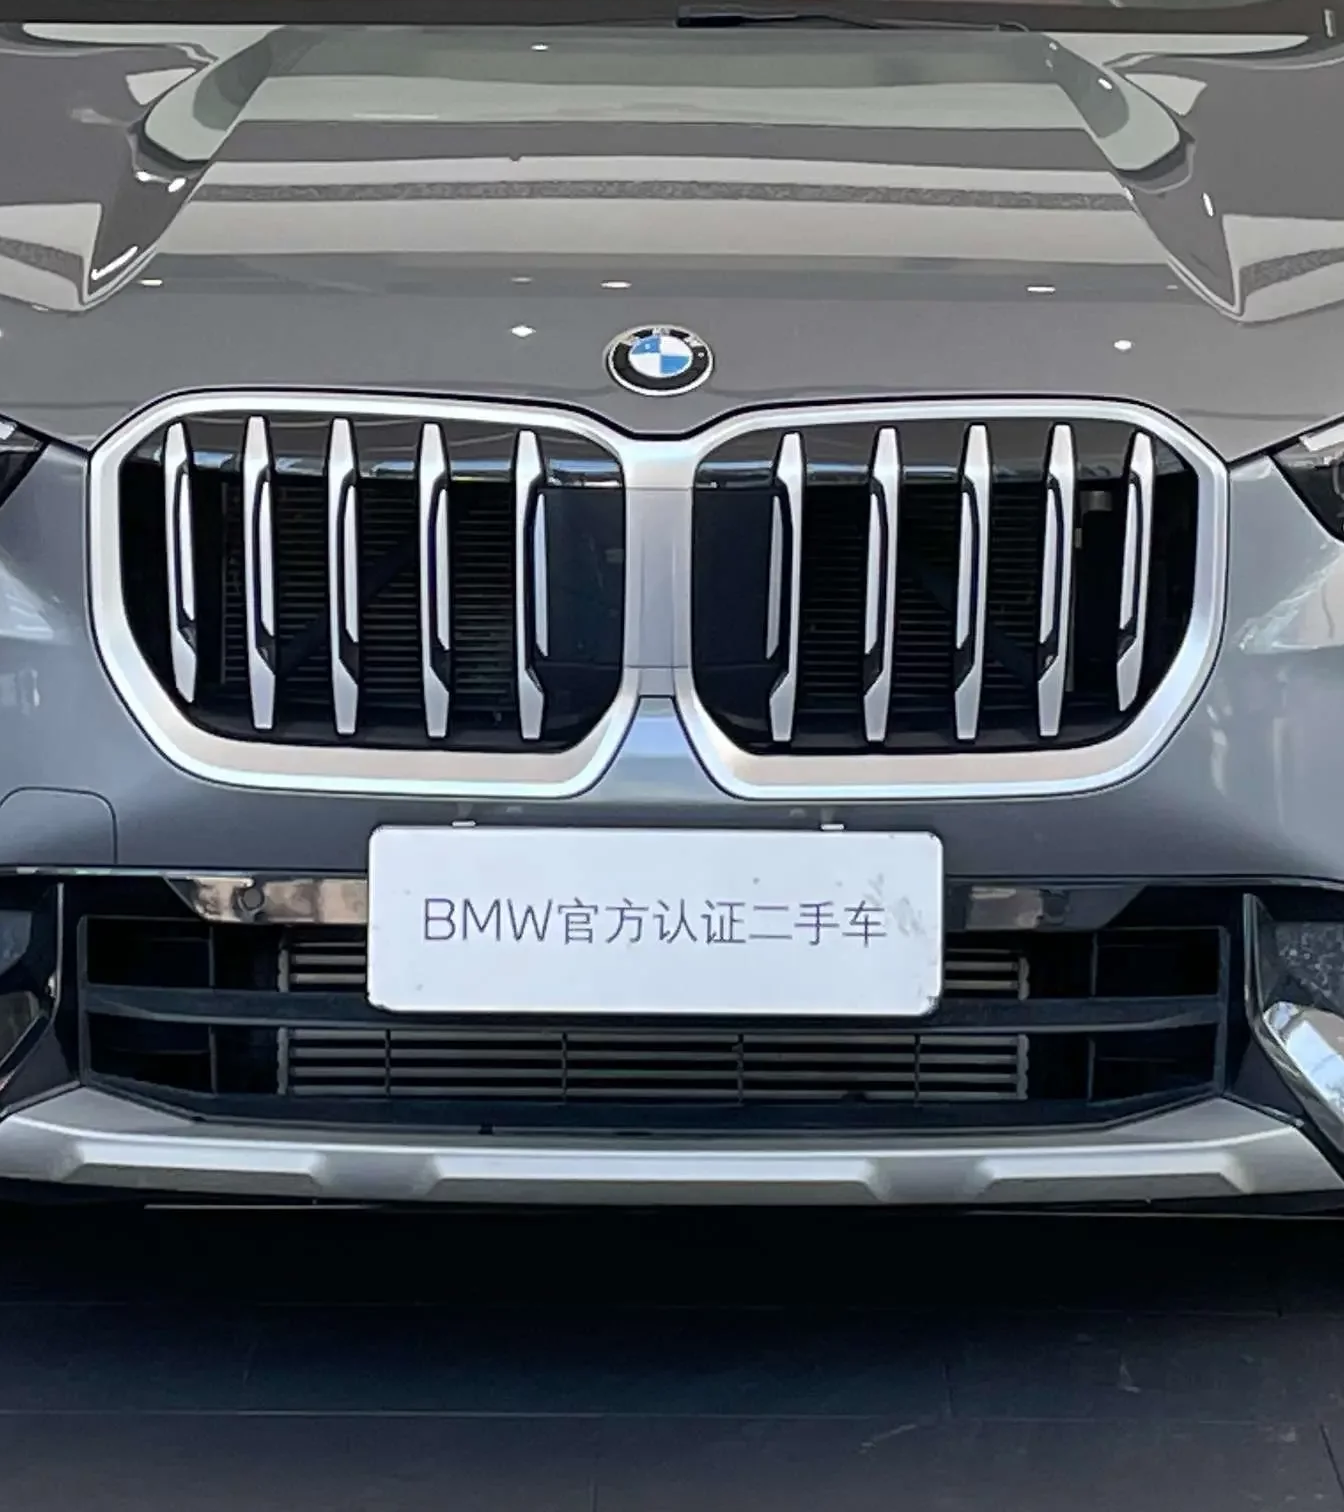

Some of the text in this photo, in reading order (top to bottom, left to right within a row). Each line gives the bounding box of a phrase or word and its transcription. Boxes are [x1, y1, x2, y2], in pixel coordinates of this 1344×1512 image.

[423, 895, 888, 949] BMW官方认证二手车
